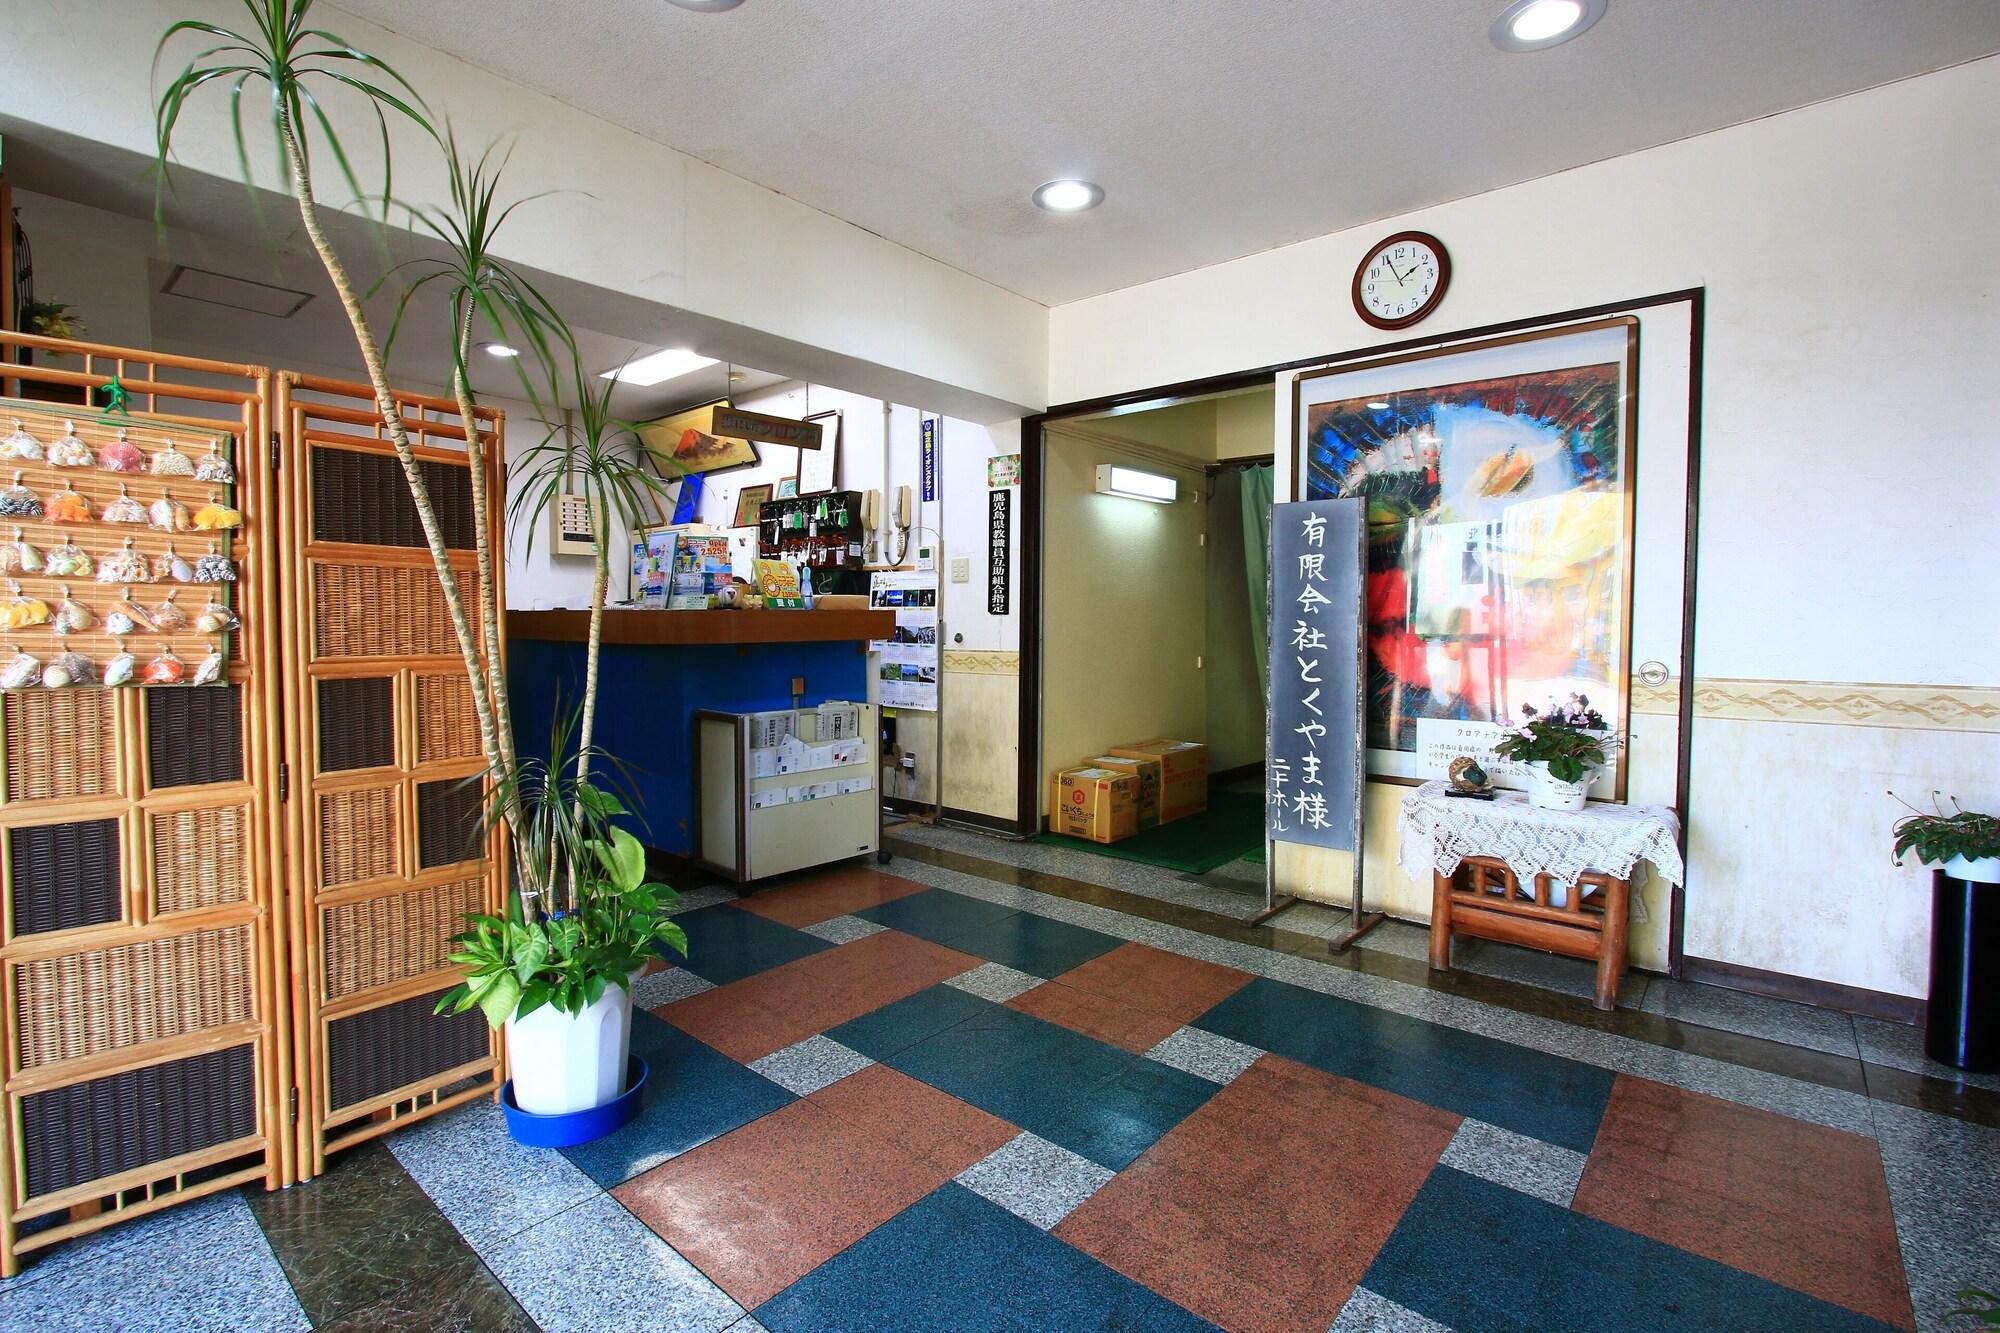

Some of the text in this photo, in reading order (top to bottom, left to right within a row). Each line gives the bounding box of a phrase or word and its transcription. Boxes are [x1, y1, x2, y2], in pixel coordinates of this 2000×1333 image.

[1394, 247, 1405, 260] 12
[1412, 247, 1416, 258] 1
[1421, 254, 1429, 265] 2
[1370, 267, 1380, 279] 10
[1426, 268, 1434, 279] 3
[1367, 283, 1375, 295] 9
[1421, 284, 1428, 295] 4
[1372, 296, 1379, 307] 8
[1411, 297, 1418, 309] 5
[1384, 303, 1391, 315] 7
[1397, 303, 1404, 315] 6
[992, 492, 1006, 613] 鹿児島県教職員互助組合指定
[1289, 511, 1334, 830] 有限会社とくやま様
